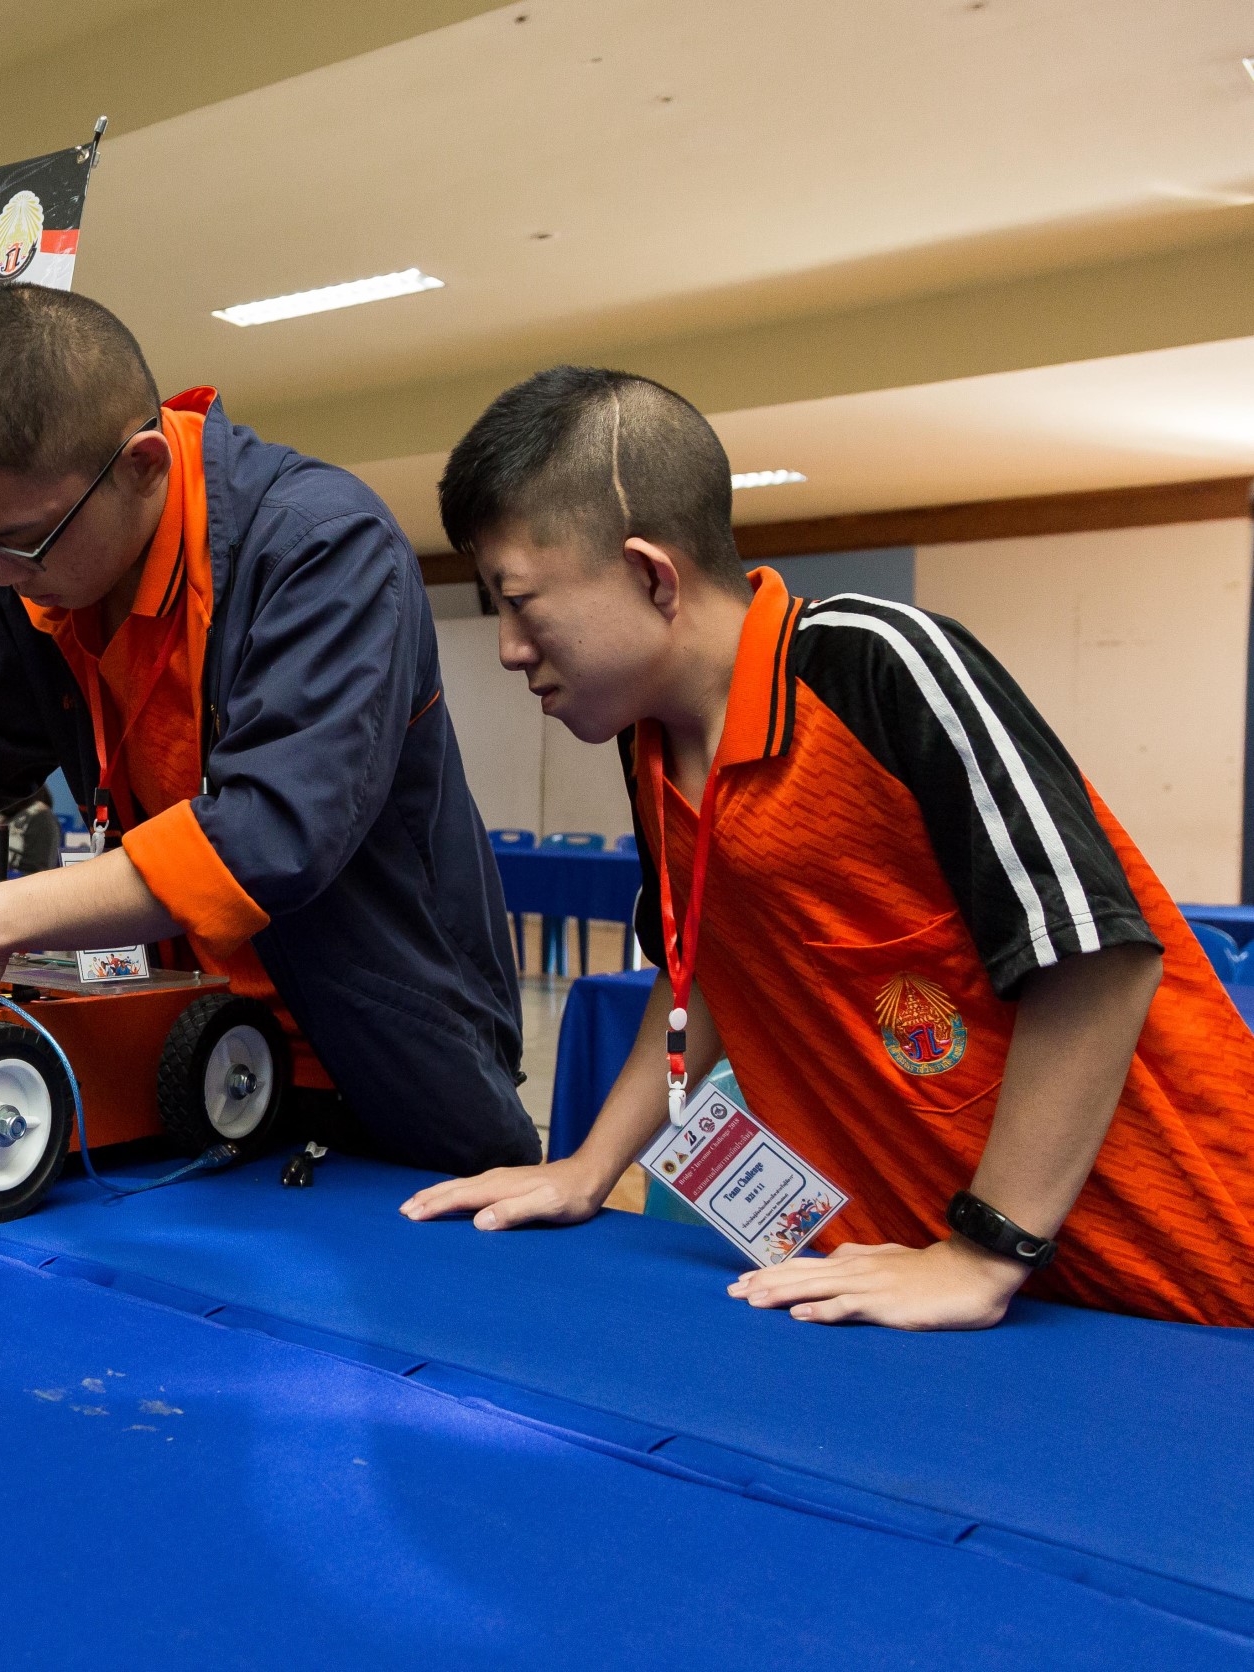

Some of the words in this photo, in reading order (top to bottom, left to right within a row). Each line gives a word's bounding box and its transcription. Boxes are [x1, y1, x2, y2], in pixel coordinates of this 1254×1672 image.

[708, 1127, 730, 1150] Challenge
[723, 1184, 741, 1203] Team
[738, 1161, 764, 1188] Challenge
[756, 1181, 765, 1191] 11
